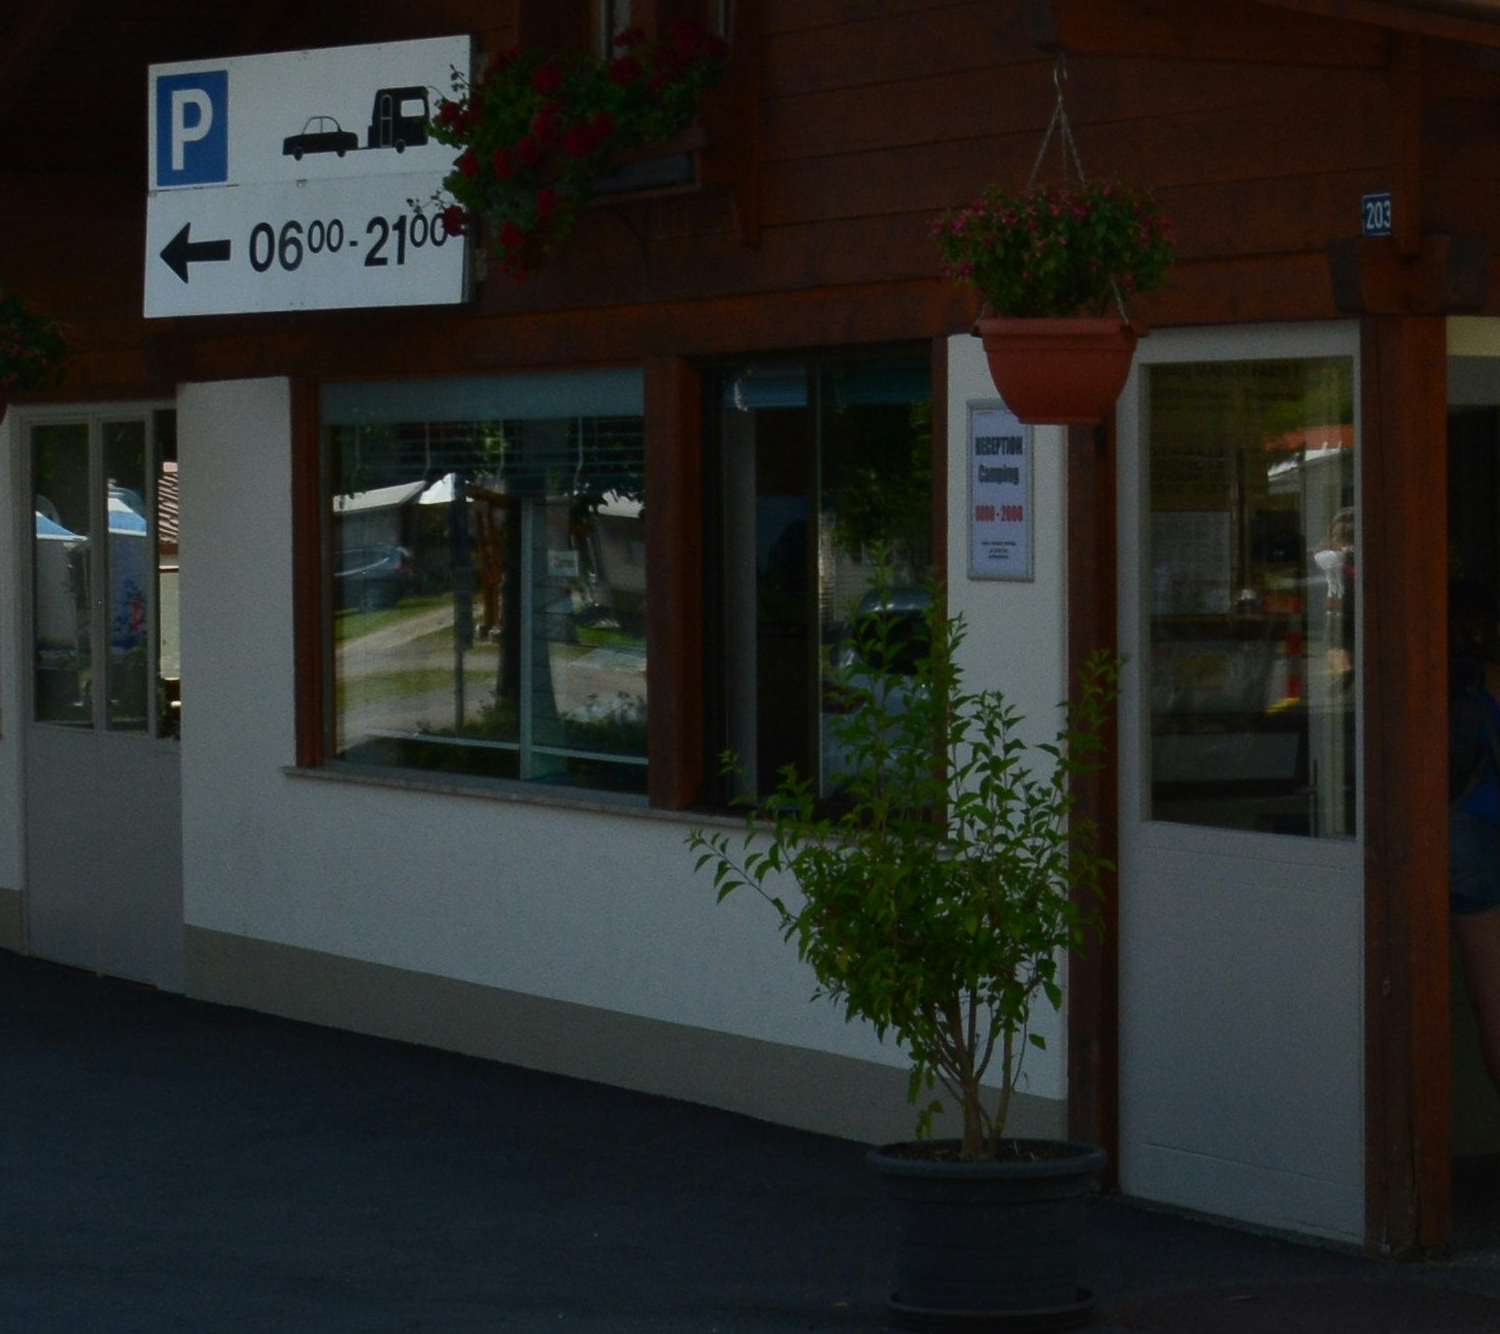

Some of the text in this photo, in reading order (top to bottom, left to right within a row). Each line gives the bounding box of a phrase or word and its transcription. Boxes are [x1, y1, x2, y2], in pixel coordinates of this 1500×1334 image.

[171, 88, 213, 171] P
[1366, 200, 1391, 230] 203
[975, 436, 1023, 455] RECEPTION
[978, 464, 1019, 485] Camping
